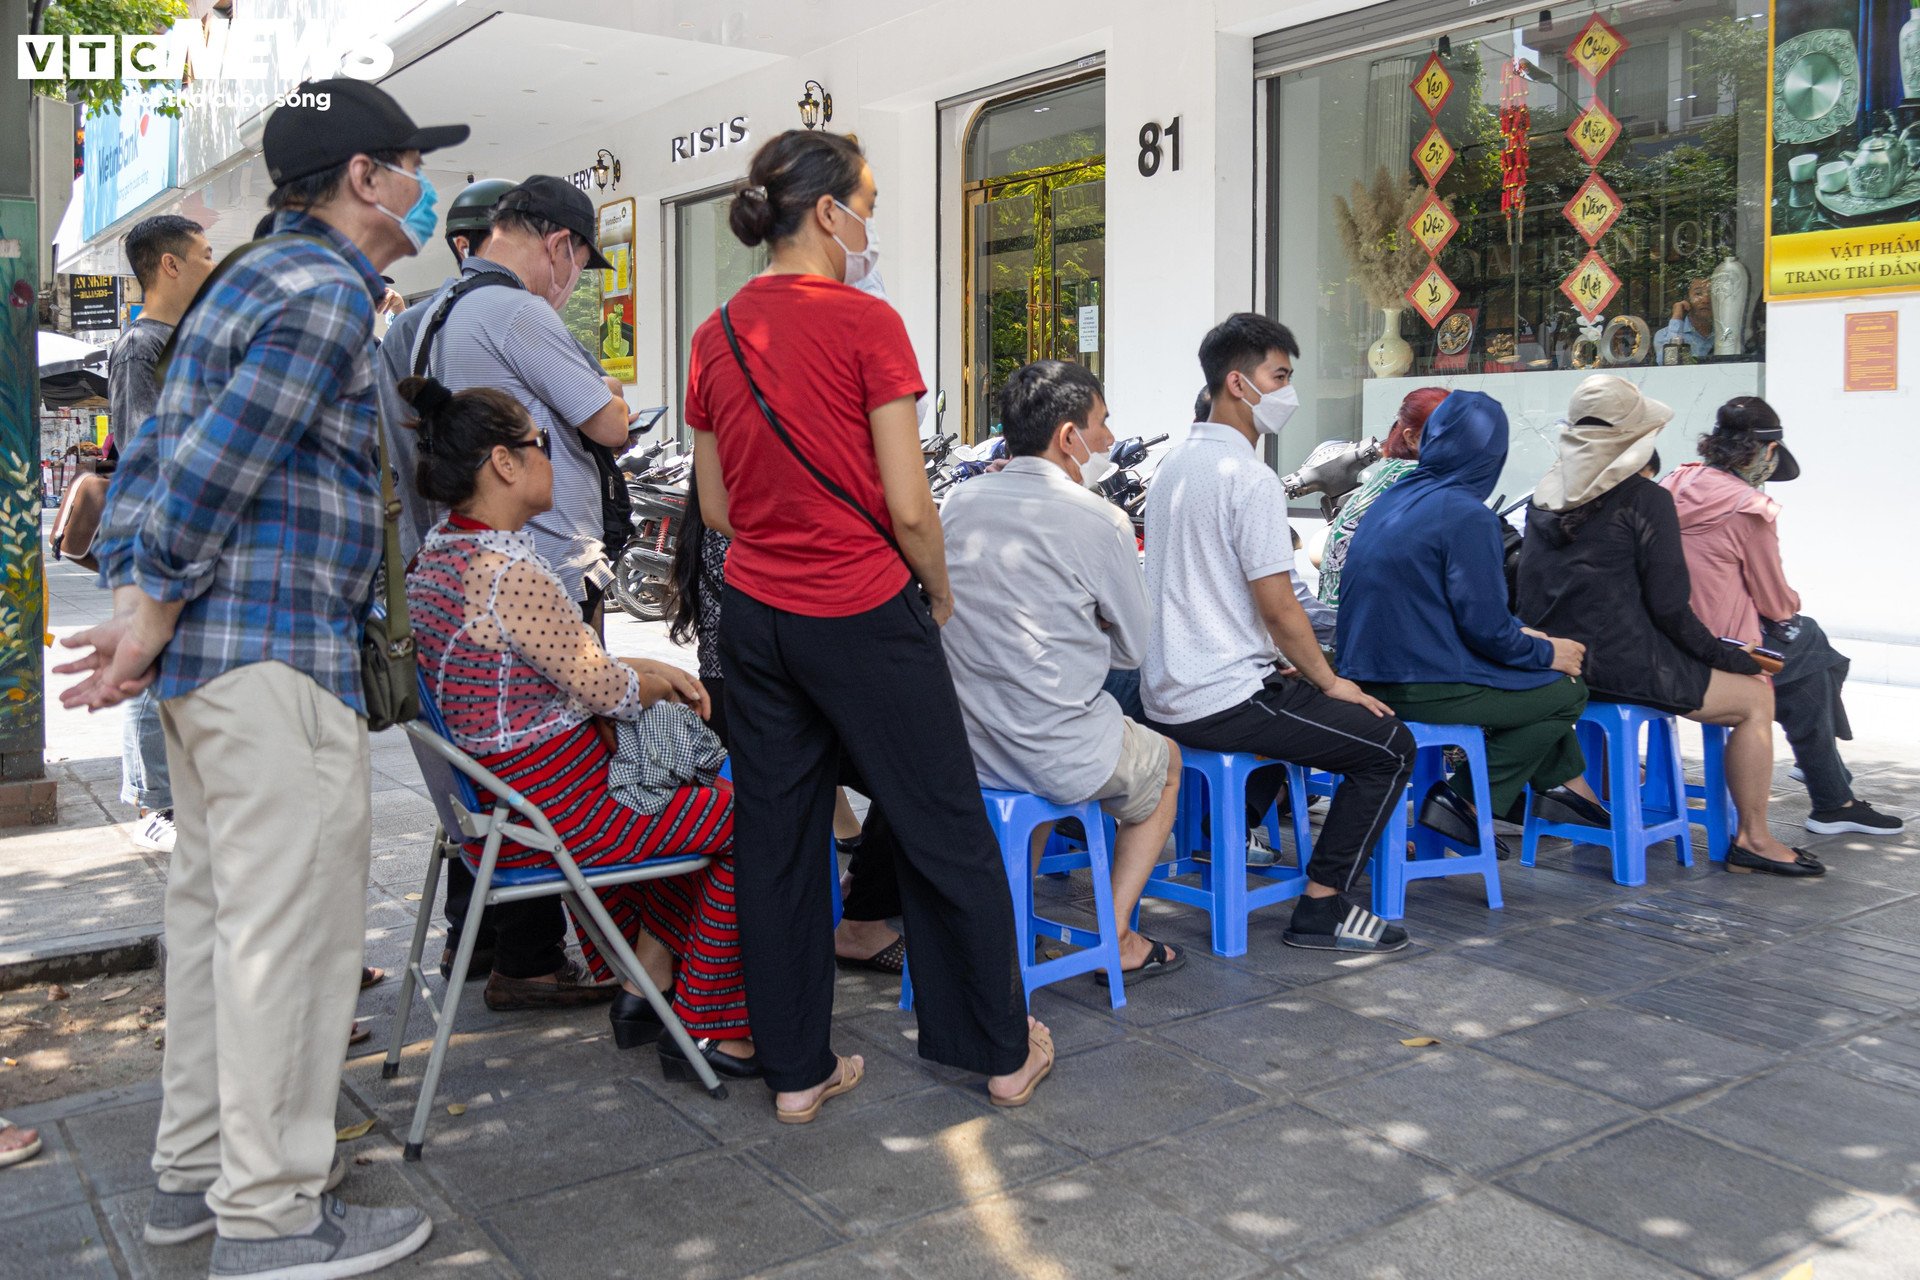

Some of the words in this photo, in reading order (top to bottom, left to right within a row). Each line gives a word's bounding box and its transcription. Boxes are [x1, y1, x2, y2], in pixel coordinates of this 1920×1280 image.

[671, 116, 749, 163] RISIS
[1138, 116, 1183, 177] 81
[1831, 243, 1864, 261] VẬT
[1869, 234, 1920, 256] PHẨM
[1785, 268, 1841, 284] TRANG
[1846, 262, 1875, 279] TRÍ
[1879, 255, 1920, 277] ĐẲN
